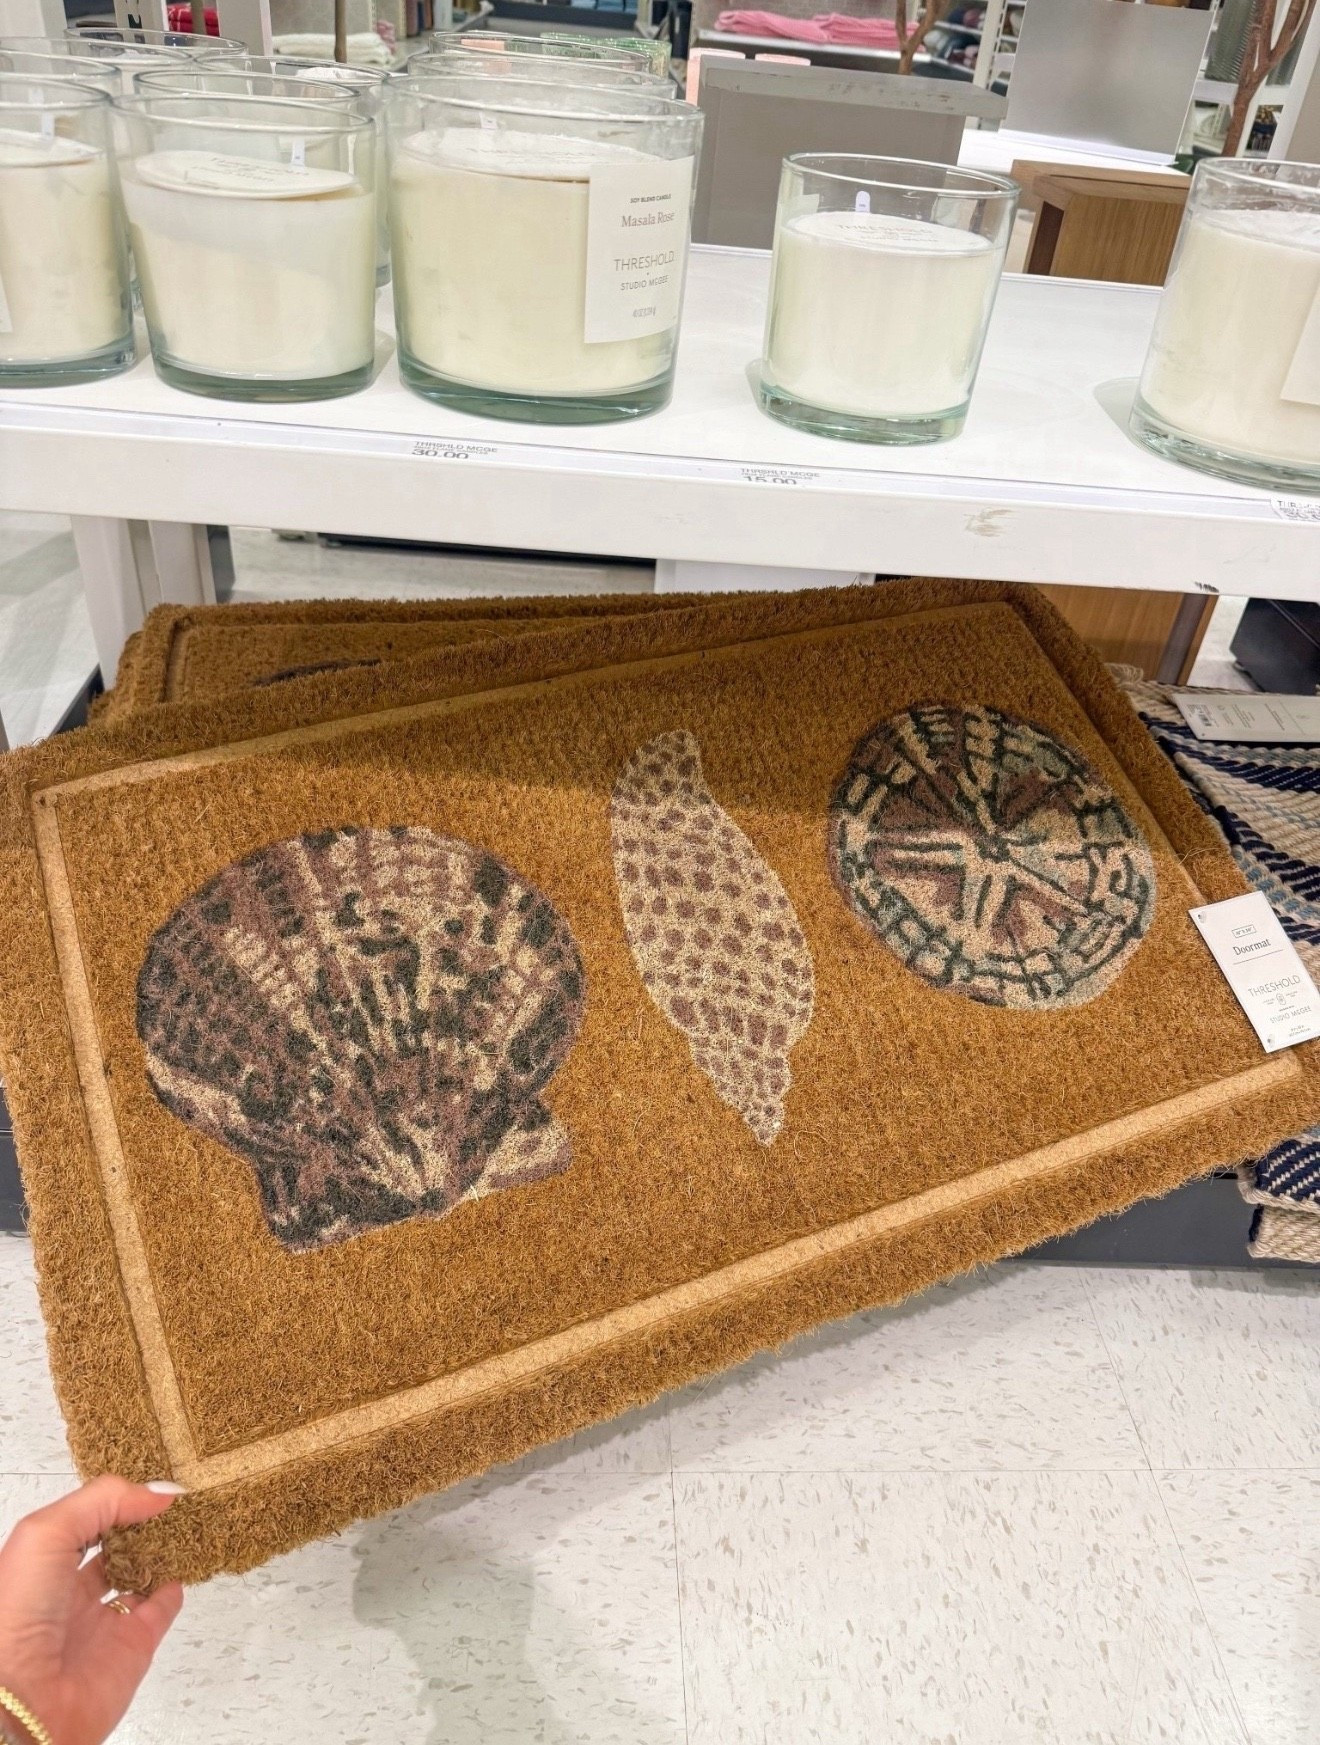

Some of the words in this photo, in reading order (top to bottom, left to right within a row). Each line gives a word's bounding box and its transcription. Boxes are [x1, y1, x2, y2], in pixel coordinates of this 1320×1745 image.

[621, 214, 655, 228] Masala
[657, 211, 675, 224] Rose
[614, 250, 675, 271] THRESHOLD
[621, 280, 647, 291] STUDIO
[412, 448, 468, 459] 30.00
[744, 475, 797, 485] 1500
[1233, 939, 1271, 955] Doormat
[1248, 975, 1300, 997] THRESHOLD
